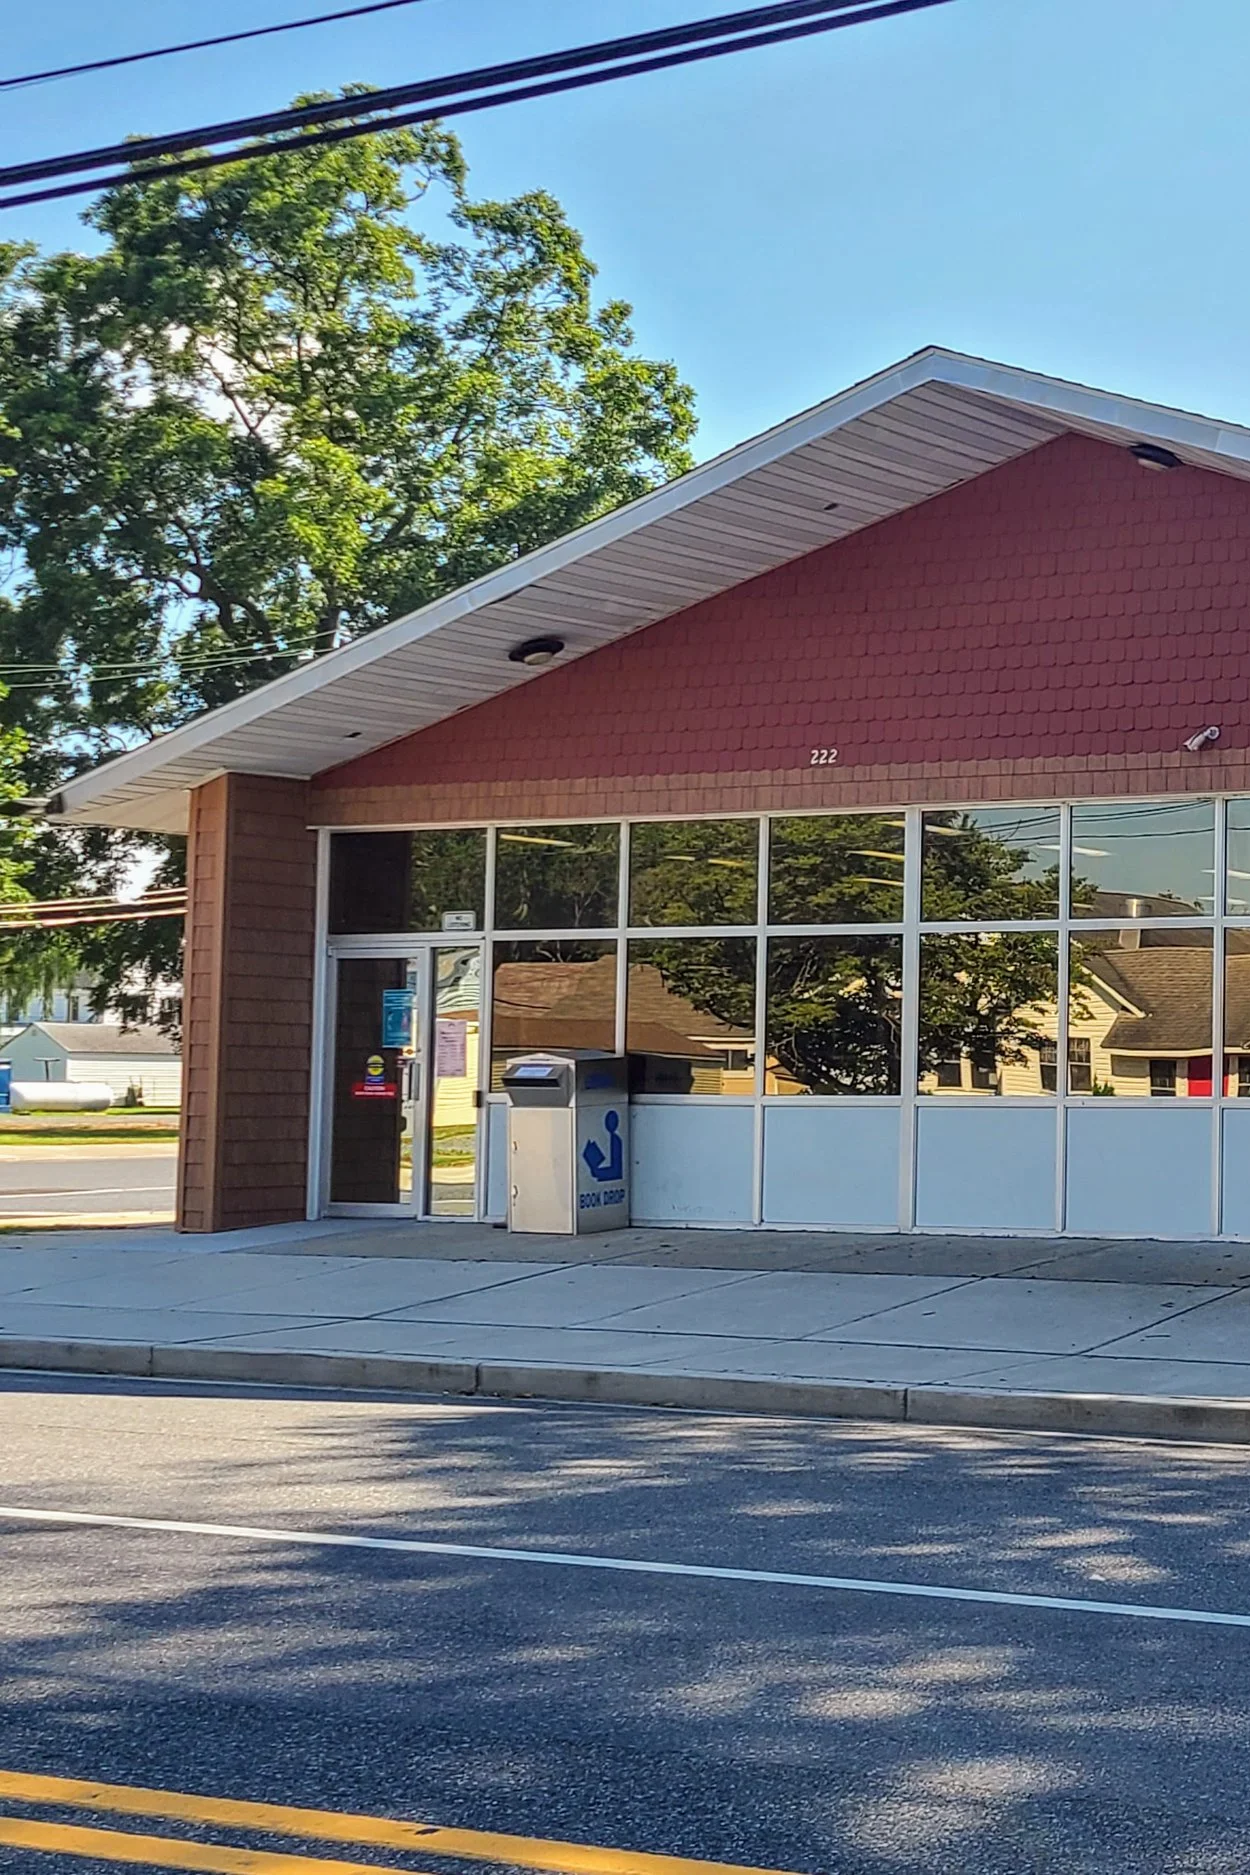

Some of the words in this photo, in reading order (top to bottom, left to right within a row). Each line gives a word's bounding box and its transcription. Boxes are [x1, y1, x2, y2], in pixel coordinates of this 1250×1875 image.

[811, 748, 838, 765] 222
[580, 1193, 602, 1209] BOOK
[604, 1189, 625, 1205] DROP
